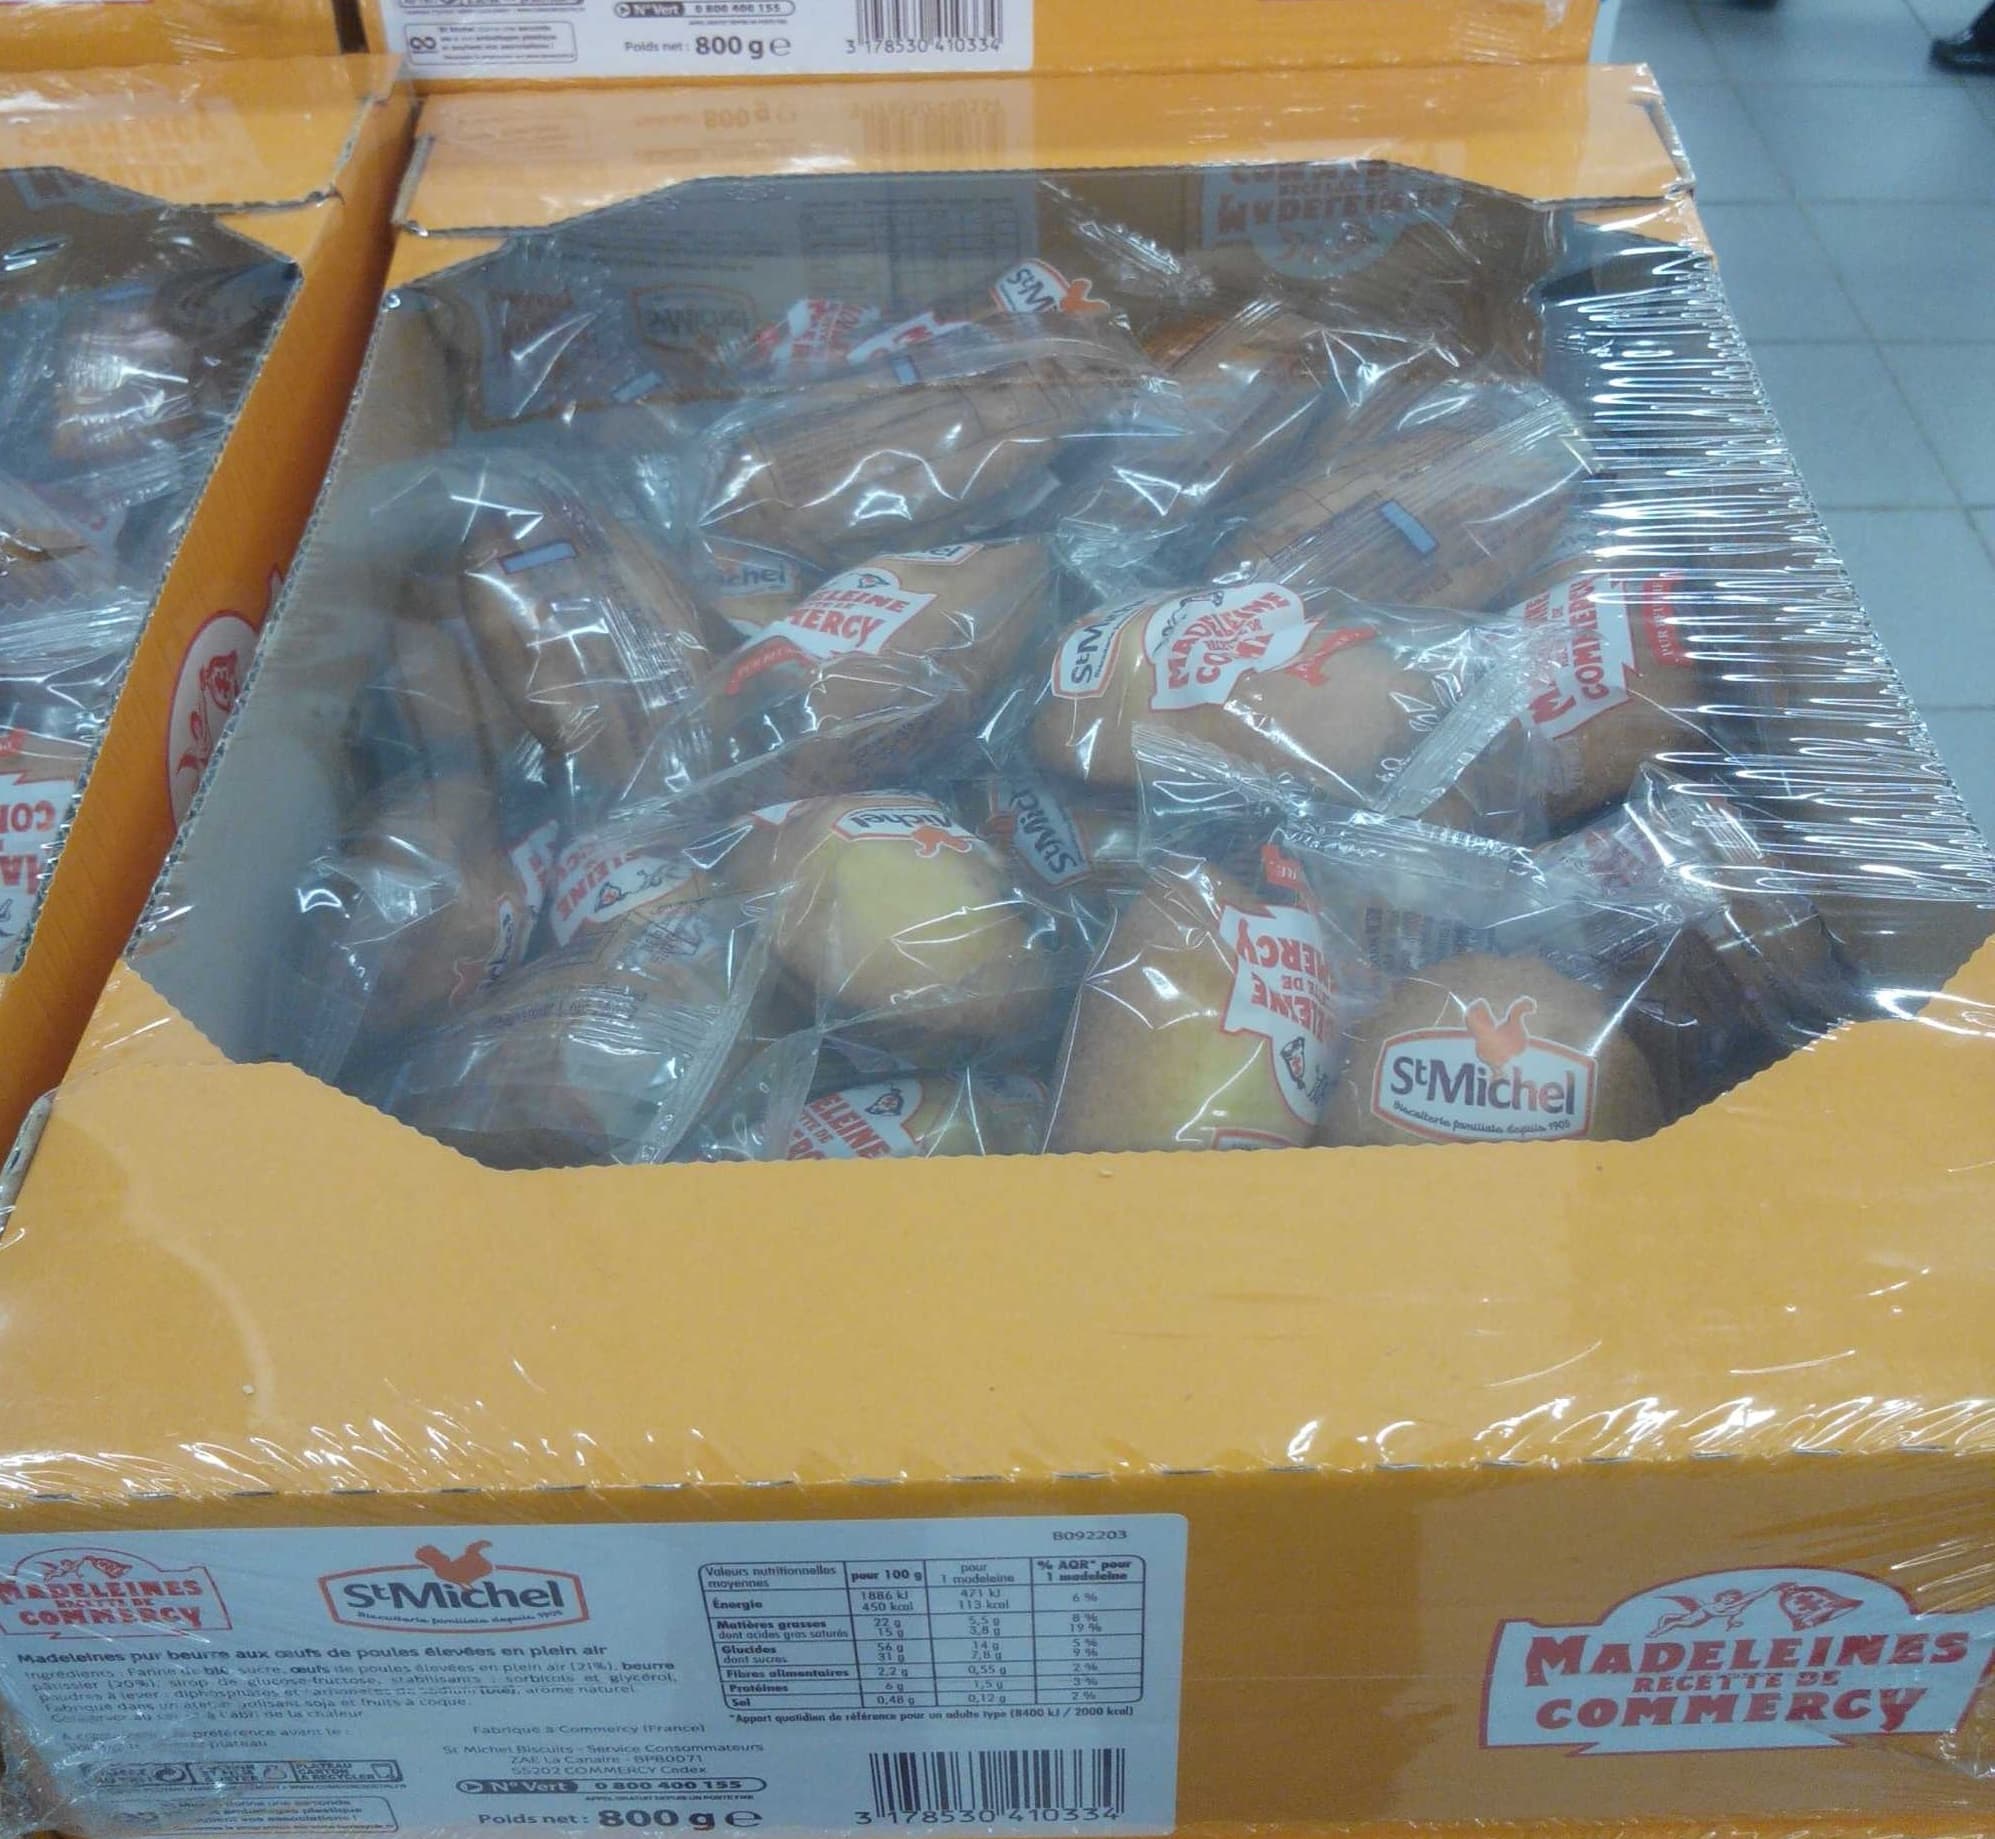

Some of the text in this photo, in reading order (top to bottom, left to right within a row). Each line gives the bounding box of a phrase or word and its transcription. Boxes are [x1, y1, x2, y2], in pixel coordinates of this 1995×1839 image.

[624, 41, 659, 52] Poids
[662, 42, 682, 51] net
[696, 36, 742, 54] 800
[749, 40, 763, 59] g
[846, 38, 1000, 53] 3 178530 410334
[1390, 1056, 1576, 1115] StMichel
[1052, 1530, 1127, 1541] B092203
[961, 1563, 987, 1573] pour
[1038, 1561, 1053, 1570] %
[1101, 1560, 1132, 1571] pour
[705, 1565, 836, 1577] Valeurs nutritionnelles
[851, 1569, 922, 1582] pour 100 g
[708, 1579, 769, 1590] moyennes
[343, 1580, 564, 1609] StMichel
[862, 1591, 893, 1600] 1886
[960, 1589, 985, 1597] 471
[862, 1602, 913, 1612] 450 kcal
[958, 1600, 1009, 1610] 113 kcal
[19, 1607, 202, 1627] COMMERCY
[969, 1616, 987, 1626] 5,5
[717, 1620, 826, 1630] Matières grasses
[874, 1618, 890, 1627] 22
[879, 1629, 892, 1637] 15
[969, 1626, 989, 1636] 3,8
[1070, 1624, 1084, 1632] 19
[718, 1629, 848, 1640] dont acides gras saturés
[721, 1645, 776, 1654] Glucides
[878, 1643, 892, 1651] 56
[973, 1641, 987, 1650] 14
[18, 1653, 126, 1664] Madeleines
[131, 1651, 160, 1665] pur
[236, 1649, 269, 1659] aux
[327, 1648, 350, 1658] de
[357, 1647, 419, 1660] poules
[424, 1646, 496, 1657] élevées
[501, 1647, 524, 1657] en
[530, 1645, 577, 1658] plein
[583, 1645, 608, 1656] air
[723, 1655, 788, 1664] dont sucres
[878, 1653, 892, 1662] 31
[970, 1651, 990, 1661] 7,8
[1525, 1632, 1970, 1687] MADELEINES
[359, 1664, 411, 1676] poules
[503, 1661, 542, 1674] plein
[546, 1661, 566, 1672] air
[622, 1661, 675, 1671] beurre
[727, 1668, 848, 1678] Fibres alimentaires
[878, 1668, 896, 1677] 2,2
[968, 1665, 995, 1675] 0,55
[974, 1680, 992, 1690] 1,5
[1632, 1670, 1841, 1693] RECETTE DE
[729, 1684, 789, 1693] Protéines
[732, 1698, 751, 1707] Sel
[877, 1696, 904, 1705] 0,48
[968, 1694, 996, 1704] 0,12
[1535, 1687, 1928, 1731] COMMERCY
[775, 1714, 826, 1724] quotidien
[829, 1713, 842, 1722] de
[900, 1712, 924, 1722] pour
[946, 1709, 979, 1719] adulte
[983, 1710, 1006, 1720] type
[1010, 1708, 1044, 1718] (8400
[1075, 1707, 1103, 1716] 2000
[1107, 1706, 1133, 1716] kcal)
[559, 1725, 639, 1735] Commercy
[643, 1724, 706, 1735] (France)
[515, 1744, 573, 1753] Biscuits
[587, 1744, 640, 1753] Service
[645, 1743, 764, 1753] Consommateurs
[563, 1766, 656, 1775] COMMERCY
[660, 1765, 706, 1774] Cedex
[521, 1780, 569, 1792] Vert
[612, 1780, 650, 1789] 800
[659, 1780, 698, 1789] 400
[703, 1780, 743, 1789] 155
[478, 1813, 541, 1825] Poids
[543, 1814, 577, 1824] net
[598, 1809, 680, 1827] 800
[688, 1810, 716, 1830] g
[855, 1807, 1118, 1825] 3 178530 410334
